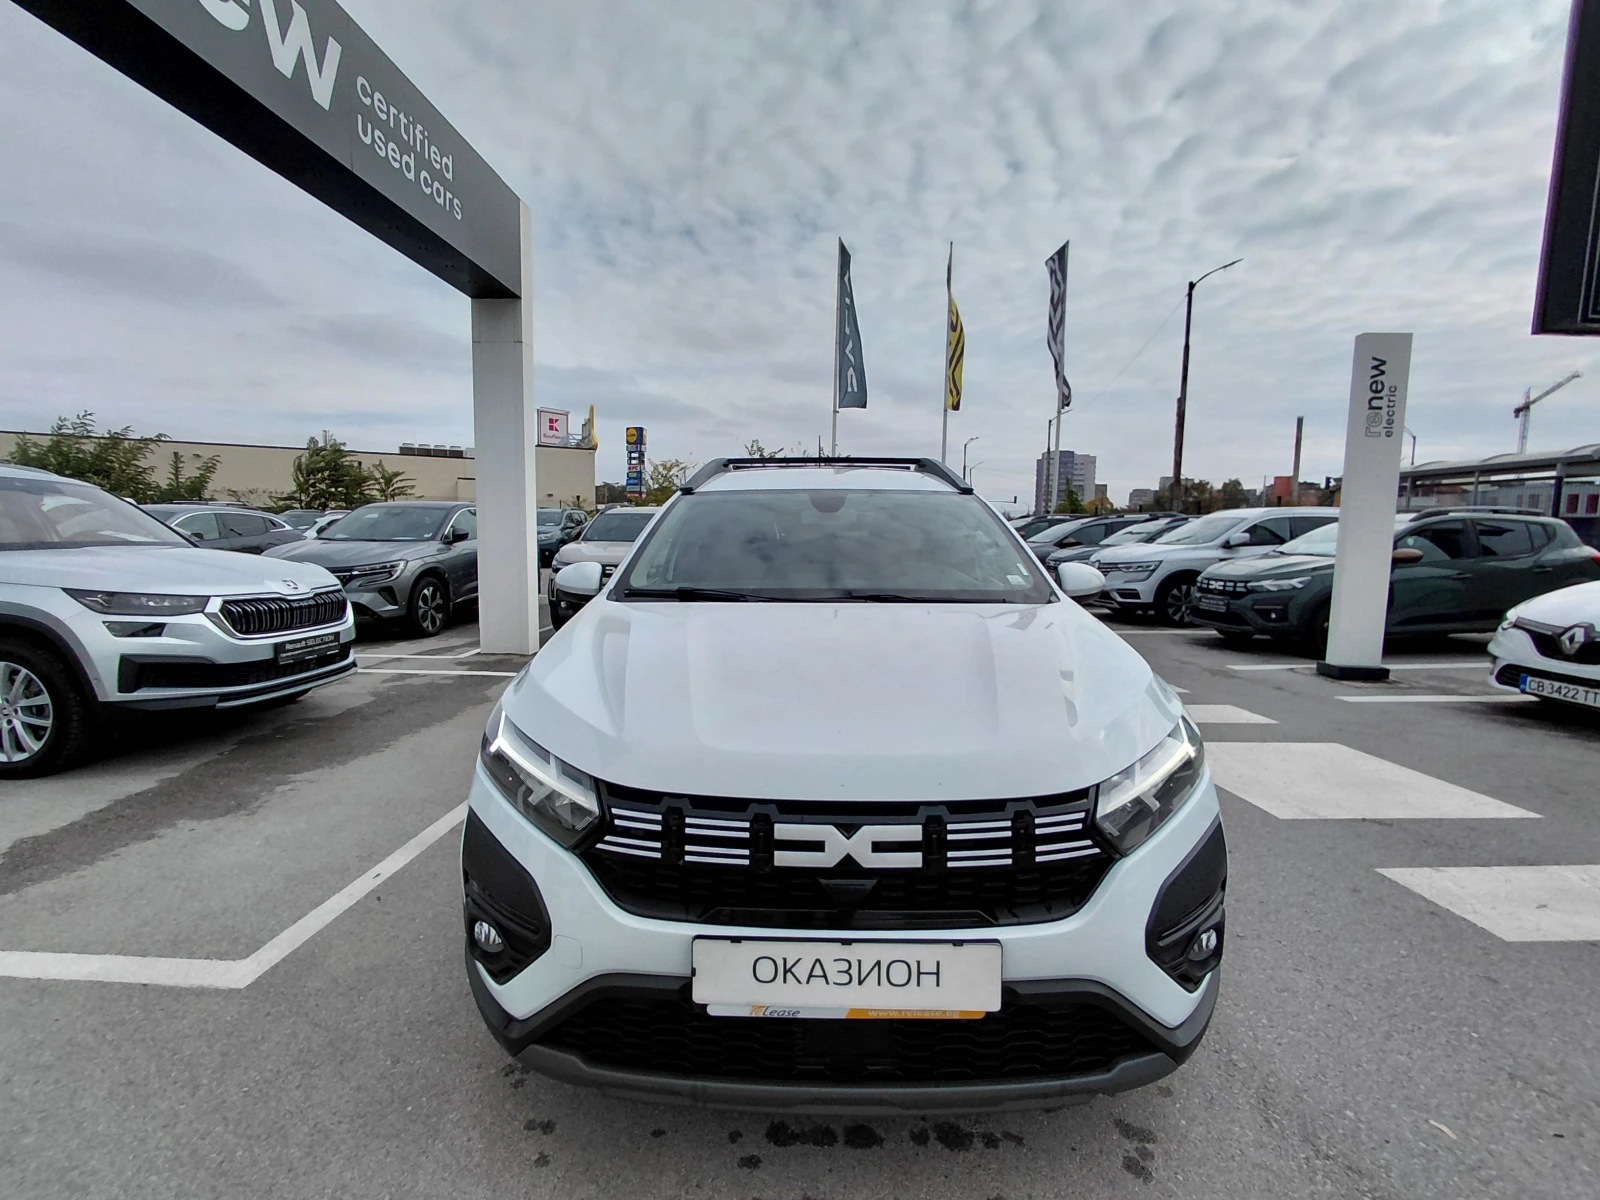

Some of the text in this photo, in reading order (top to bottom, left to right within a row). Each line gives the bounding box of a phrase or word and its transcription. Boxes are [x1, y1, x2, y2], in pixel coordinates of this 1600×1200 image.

[356, 75, 454, 183] certified
[357, 113, 463, 221] used cars
[1365, 356, 1387, 438] renew
[1383, 385, 1398, 438] electric
[286, 640, 306, 649] Renault
[306, 634, 334, 645] SELECTION
[1547, 683, 1580, 700] 3422
[1583, 690, 1600, 704] TT
[752, 955, 941, 988] ОКАЗИОН
